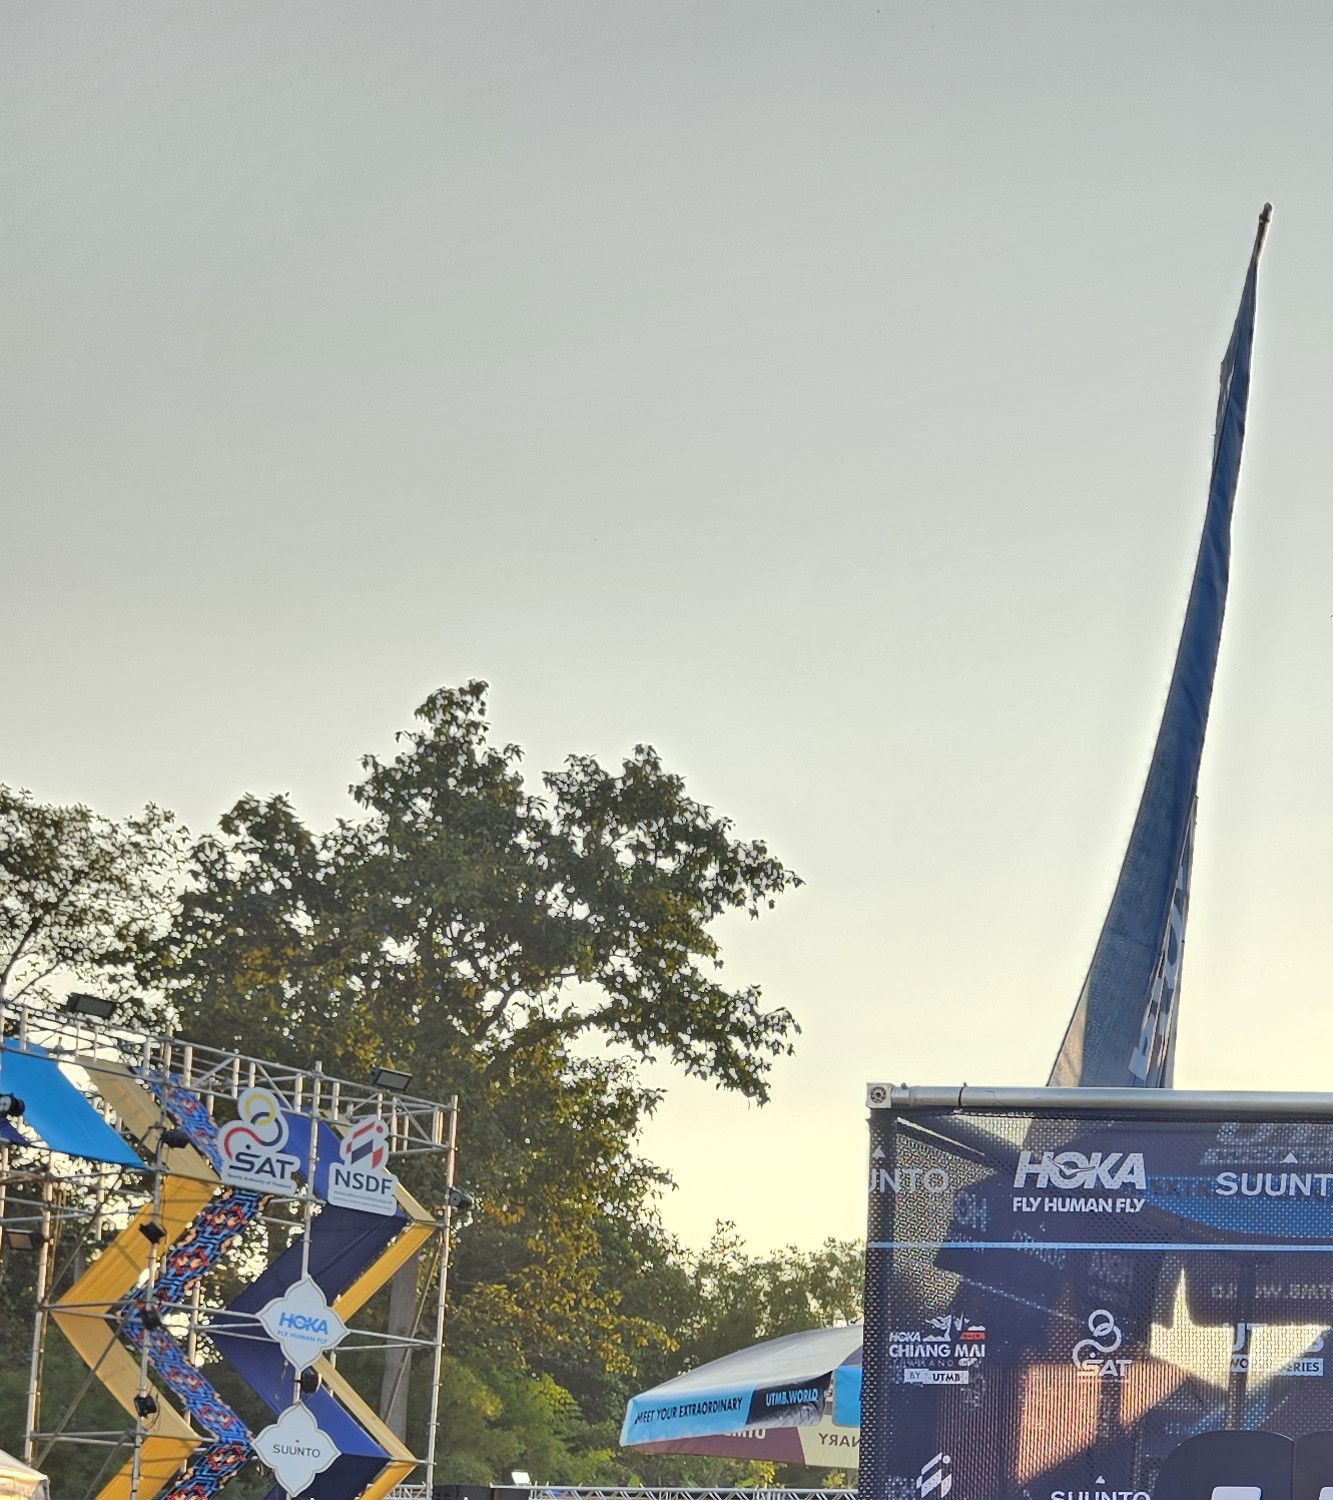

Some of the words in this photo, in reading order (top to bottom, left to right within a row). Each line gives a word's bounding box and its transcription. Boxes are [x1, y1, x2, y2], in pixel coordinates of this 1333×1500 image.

[229, 1152, 295, 1180] SAT
[1013, 1151, 1147, 1190] HOKA
[334, 1168, 393, 1195] NSDF
[1012, 1197, 1042, 1212] FLY
[1044, 1197, 1112, 1213] HUMAN
[1115, 1198, 1146, 1214] FLY
[279, 1312, 329, 1336] HOKA
[889, 1331, 922, 1343] HOKA
[888, 1344, 951, 1358] CHIANG
[954, 1344, 986, 1358] MAI
[909, 1371, 921, 1380] BY
[932, 1373, 961, 1383] UTMB
[1077, 1360, 1133, 1377] SAT
[765, 1388, 819, 1408] UTMB.WORLD
[635, 1409, 655, 1424] MEET
[656, 1407, 677, 1421] YOUR
[679, 1397, 743, 1418] EXTRAORDINARY
[273, 1444, 321, 1459] SUUNTO
